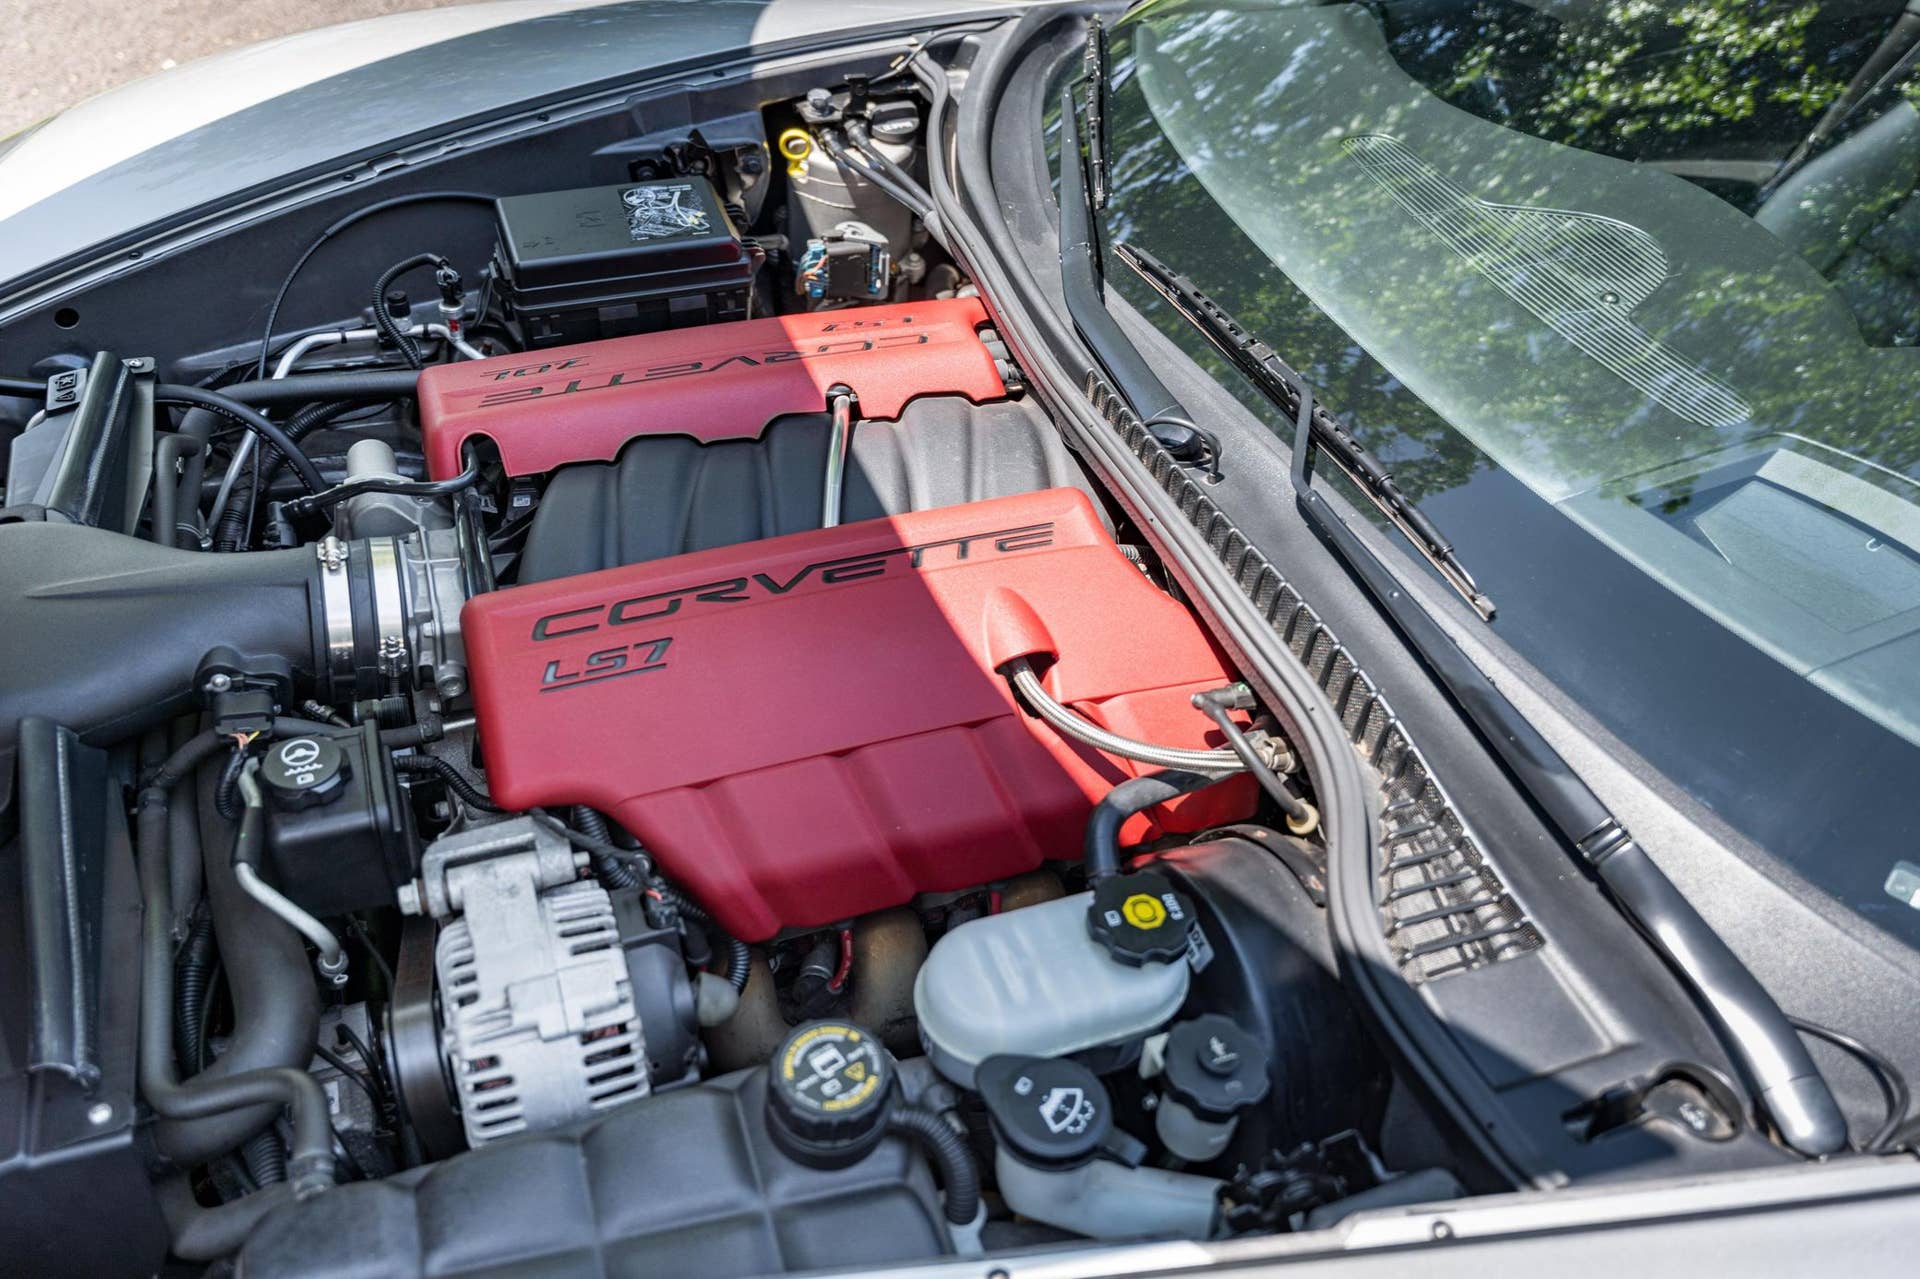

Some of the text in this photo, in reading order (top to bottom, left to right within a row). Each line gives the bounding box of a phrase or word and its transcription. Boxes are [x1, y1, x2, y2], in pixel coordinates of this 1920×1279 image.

[477, 332, 930, 409] CORVETTE
[531, 521, 1055, 642] CORVETTE
[541, 636, 674, 685] LS7
